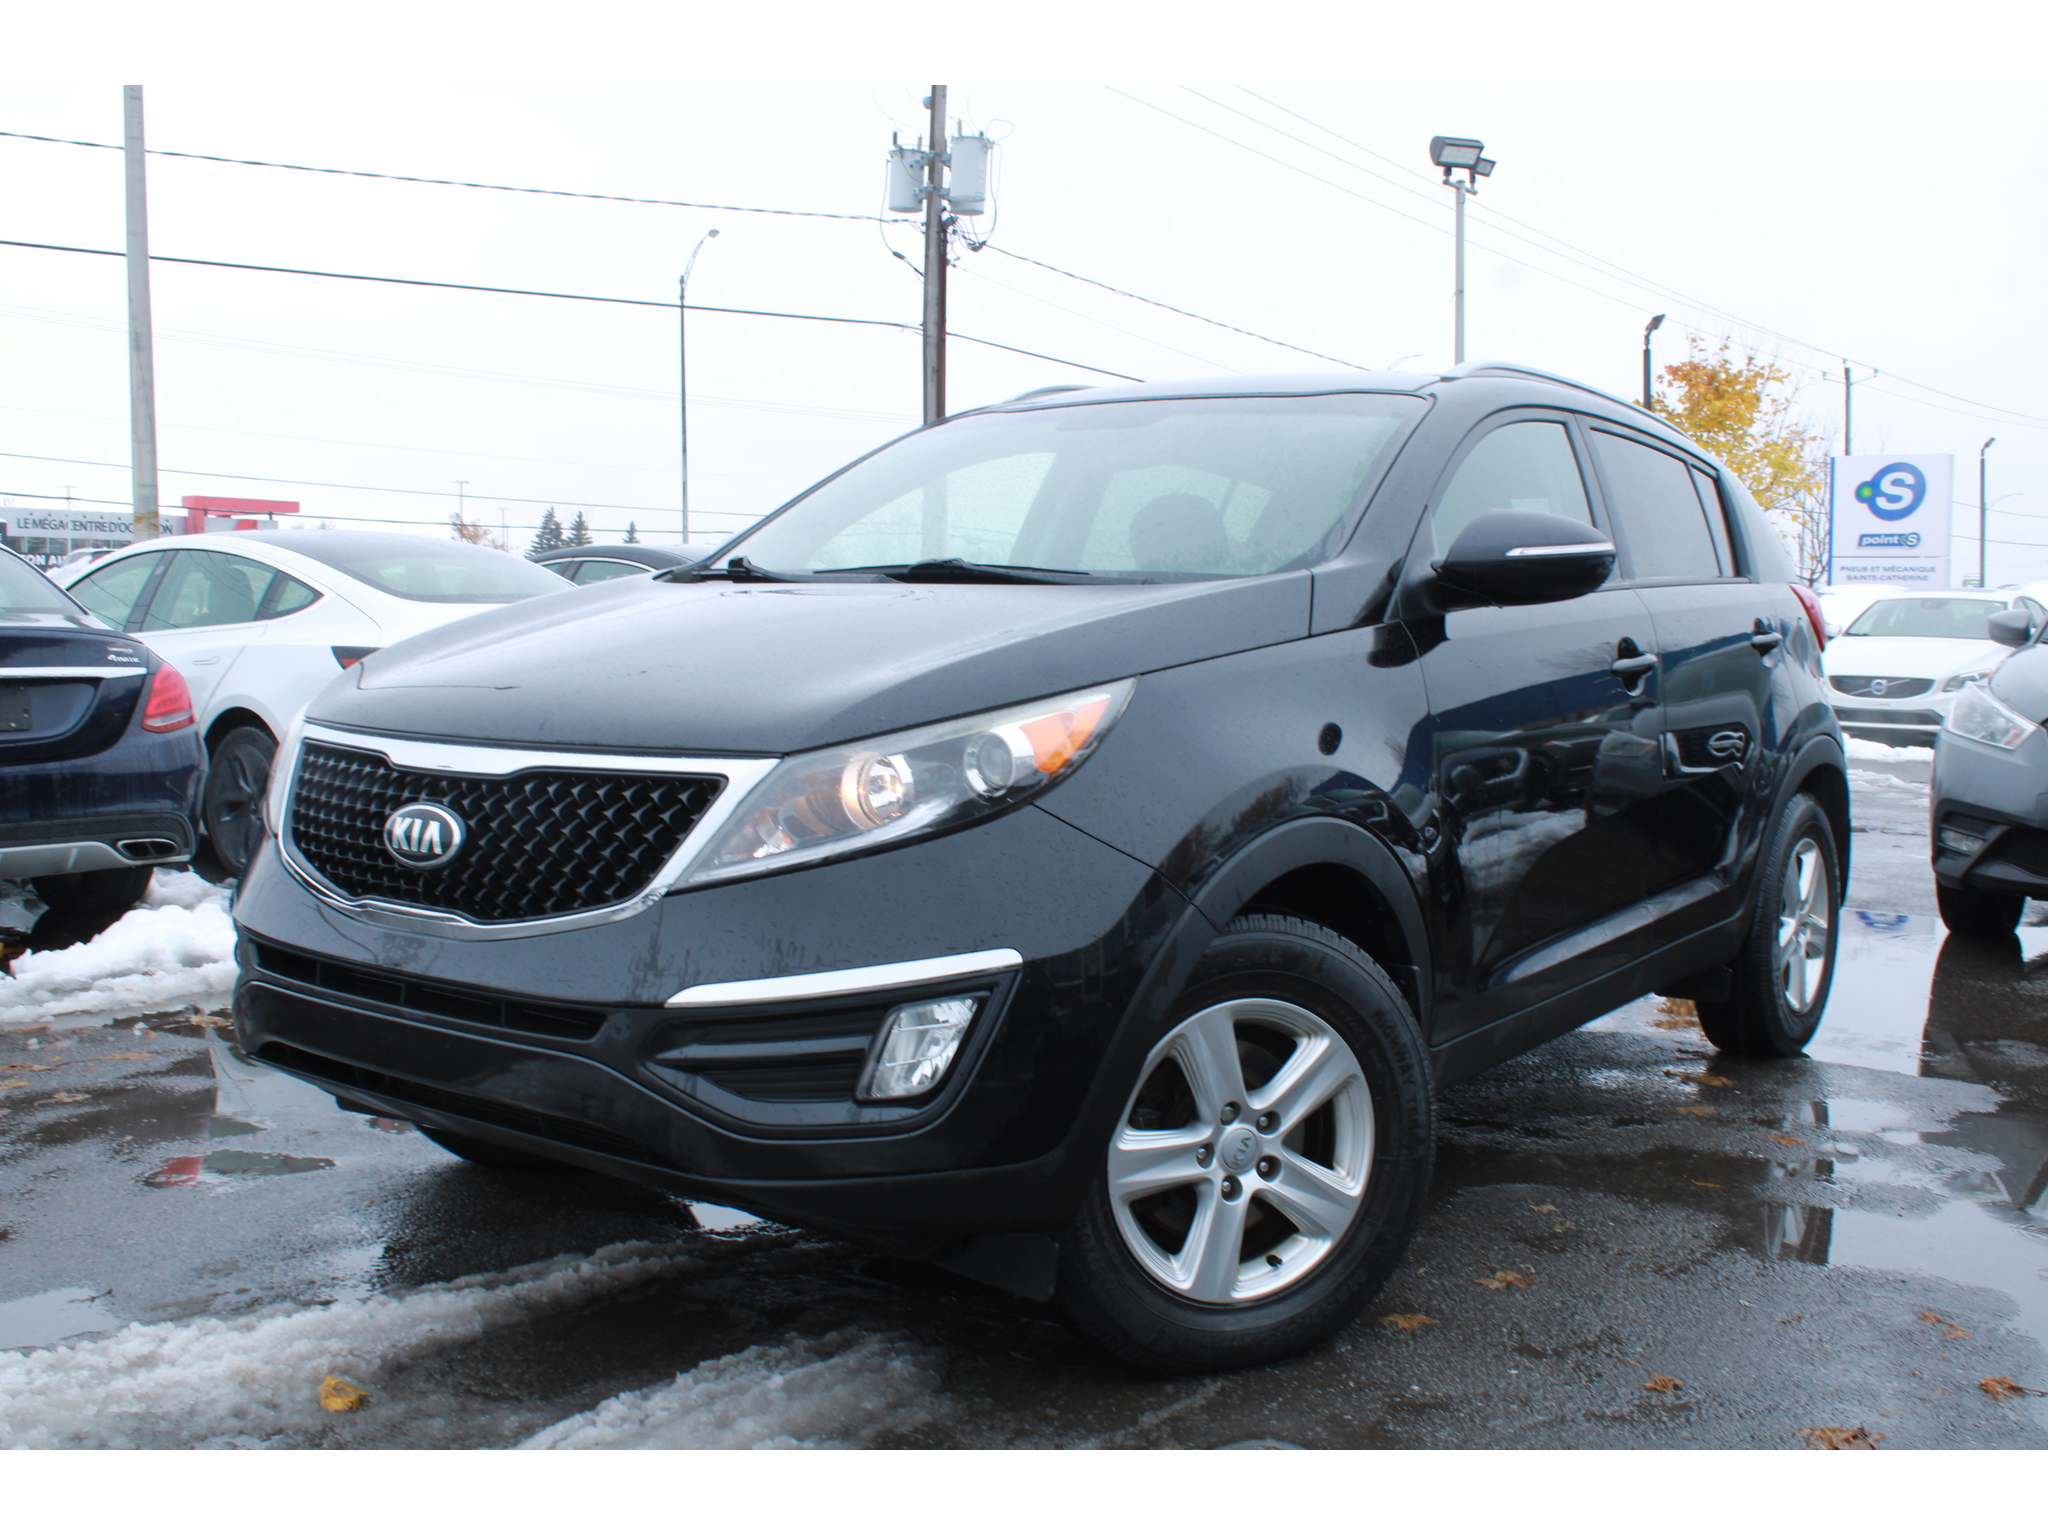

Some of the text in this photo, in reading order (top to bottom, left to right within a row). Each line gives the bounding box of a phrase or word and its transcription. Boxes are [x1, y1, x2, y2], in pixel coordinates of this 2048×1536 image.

[17, 517, 31, 529] LE
[1861, 535, 1900, 546] point
[1882, 565, 1936, 573] MÉCANIQUE
[392, 816, 444, 855] KIA
[1371, 1008, 1416, 1086] HIGHWAY
[1231, 1136, 1252, 1167] KIA
